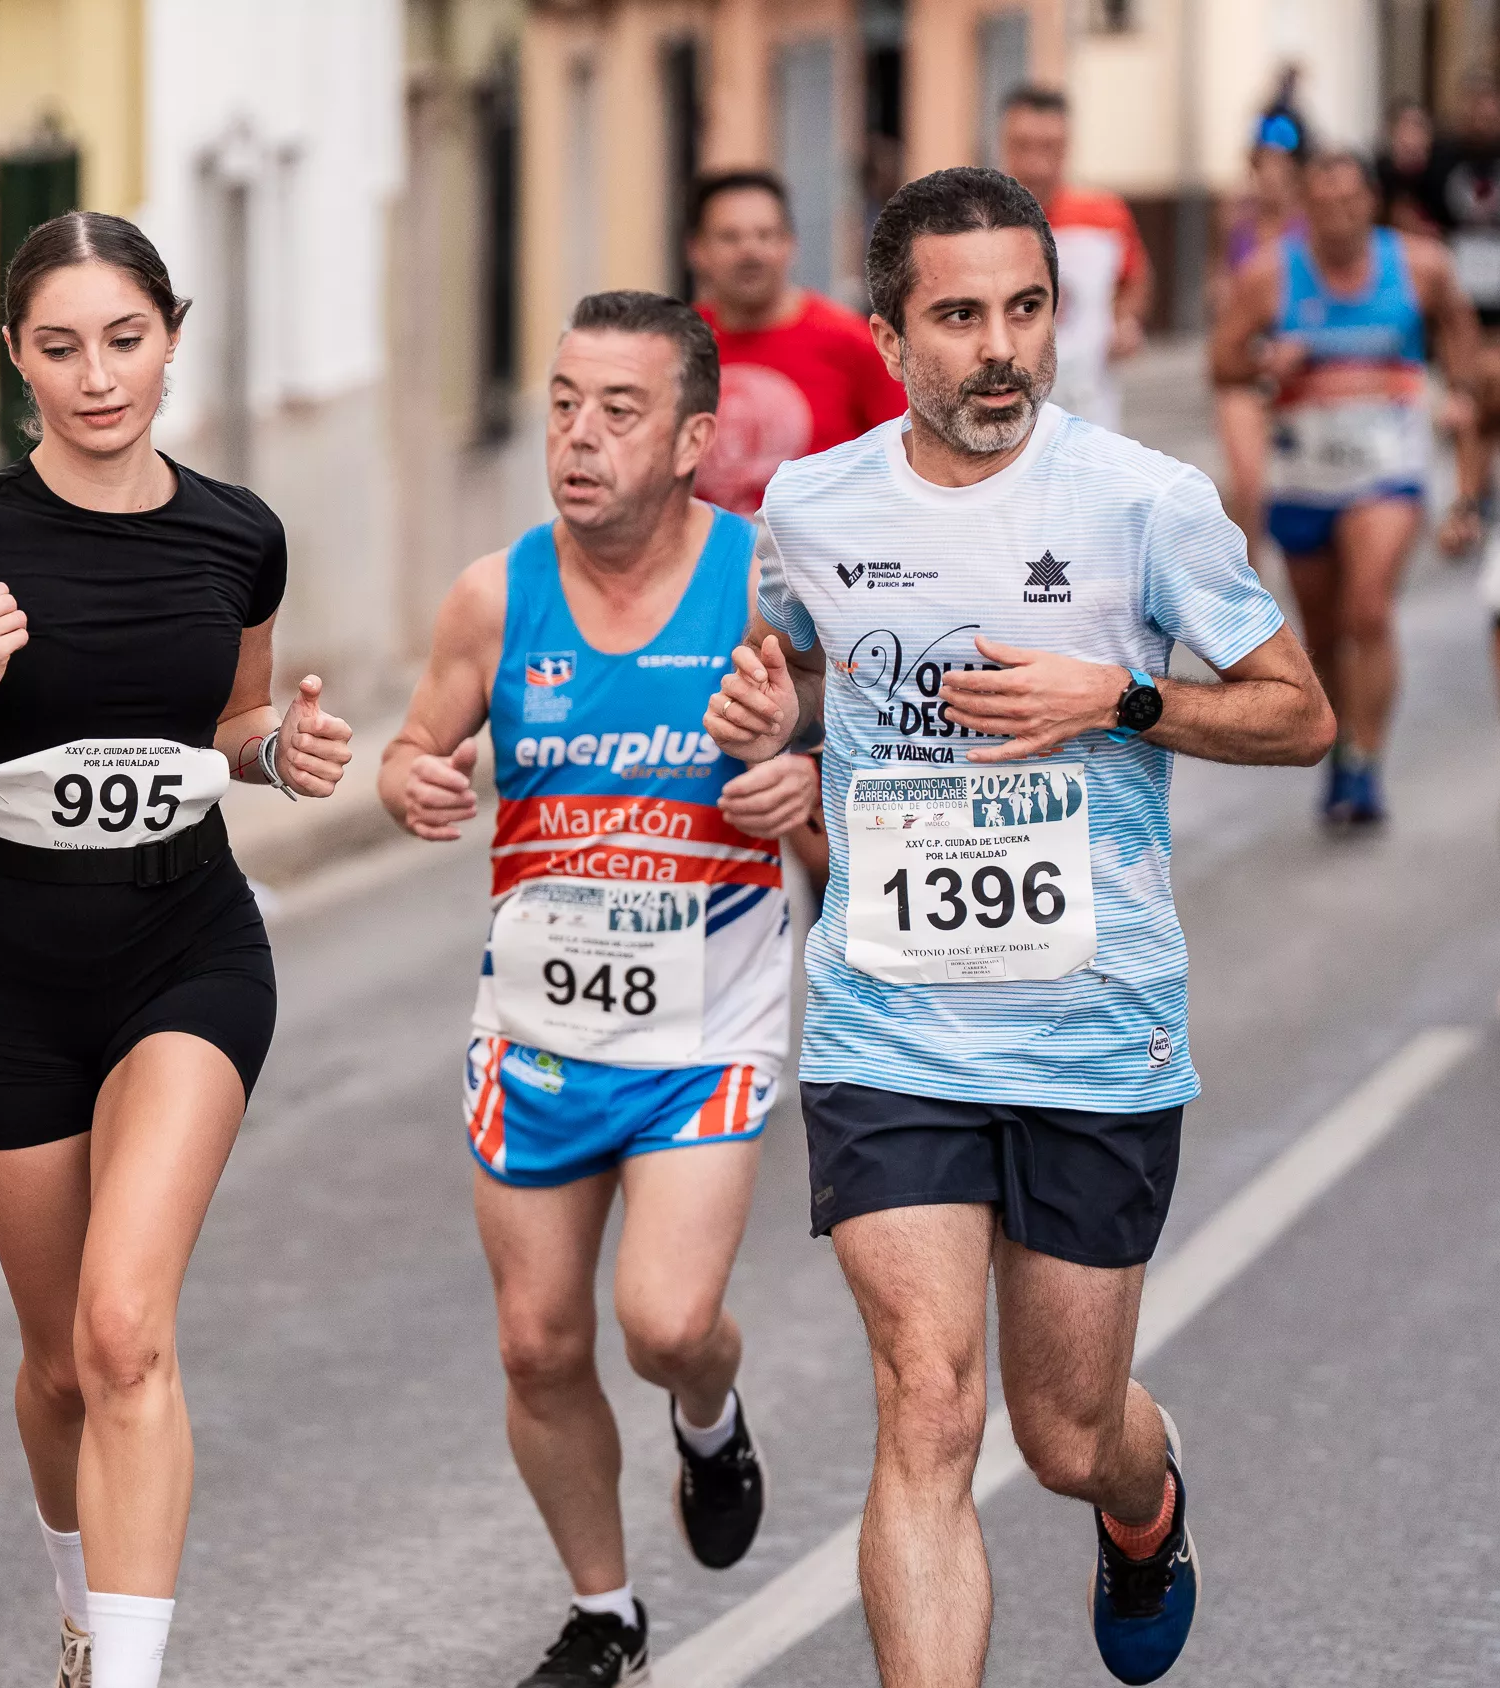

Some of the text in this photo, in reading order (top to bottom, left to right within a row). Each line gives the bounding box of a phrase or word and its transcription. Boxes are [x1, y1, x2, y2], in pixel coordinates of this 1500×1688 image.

[867, 562, 901, 570] VALENCIA
[867, 571, 939, 579] TRINIDAD ALFONSO
[1023, 590, 1072, 603] luanvi
[64, 746, 181, 756] XXV C.P. CIUDAD DE LUCENA
[515, 724, 721, 774] enerplus
[896, 744, 954, 763] VALENCIA
[83, 759, 160, 767] POR LA IGUALDAD
[620, 763, 712, 780] directo
[855, 778, 968, 791] CIRCUITO PROVINCIAL DE
[970, 773, 1035, 800] 2024
[853, 788, 968, 802] CARRERAS POPULARES
[51, 773, 183, 833] 995
[853, 801, 904, 812] DIPUTACIÓN
[909, 802, 920, 810] DE
[539, 800, 693, 839] Maratón
[53, 840, 79, 849] ROSA
[905, 834, 1031, 849] XXV C.P. CIUDAD DE LUCENA
[925, 849, 1008, 861] POR LA IGUALDAD
[546, 850, 678, 882] Lucena
[883, 861, 1067, 932] 1396
[900, 942, 1050, 957] ANTONIO JOSÉ PÉREZ DOBLAS
[543, 958, 658, 1017] 948
